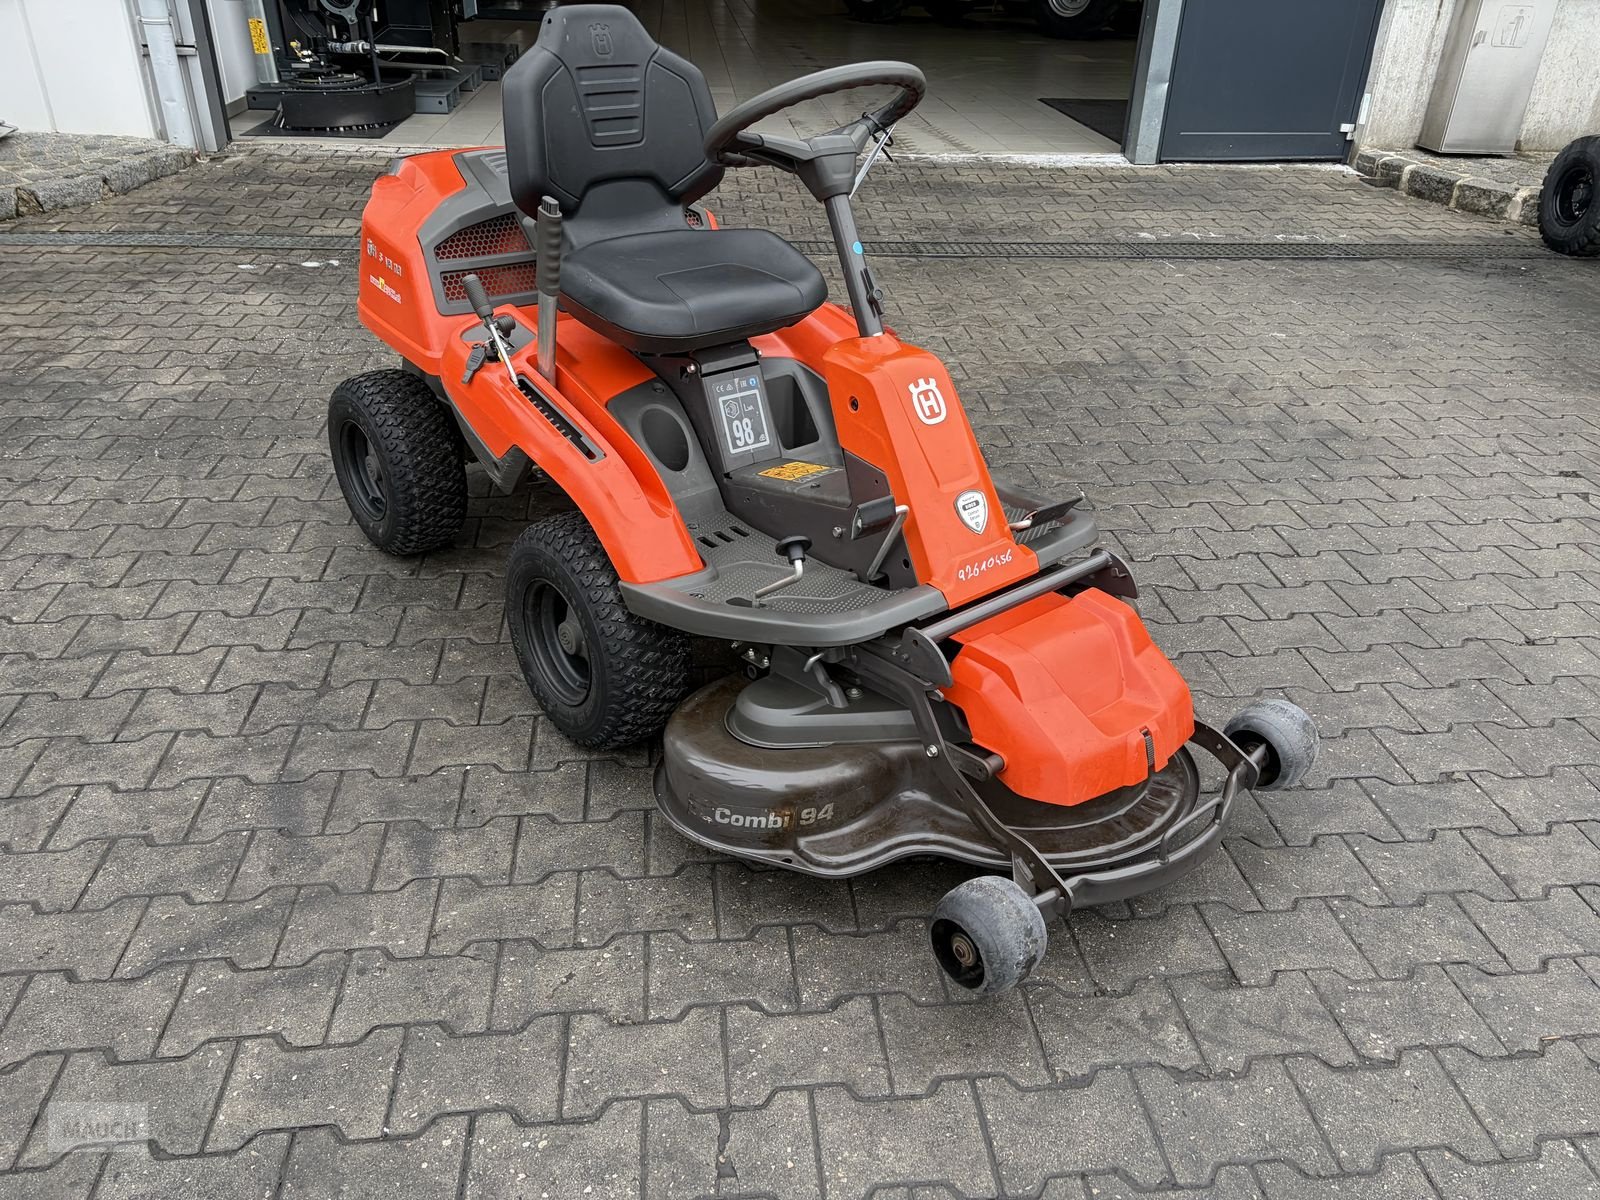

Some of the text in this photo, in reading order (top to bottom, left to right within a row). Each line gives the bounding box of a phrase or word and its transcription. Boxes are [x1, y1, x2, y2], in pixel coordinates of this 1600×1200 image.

[732, 417, 755, 447] 98
[958, 548, 1013, 581] 92610456
[714, 802, 835, 829] Combi 94
